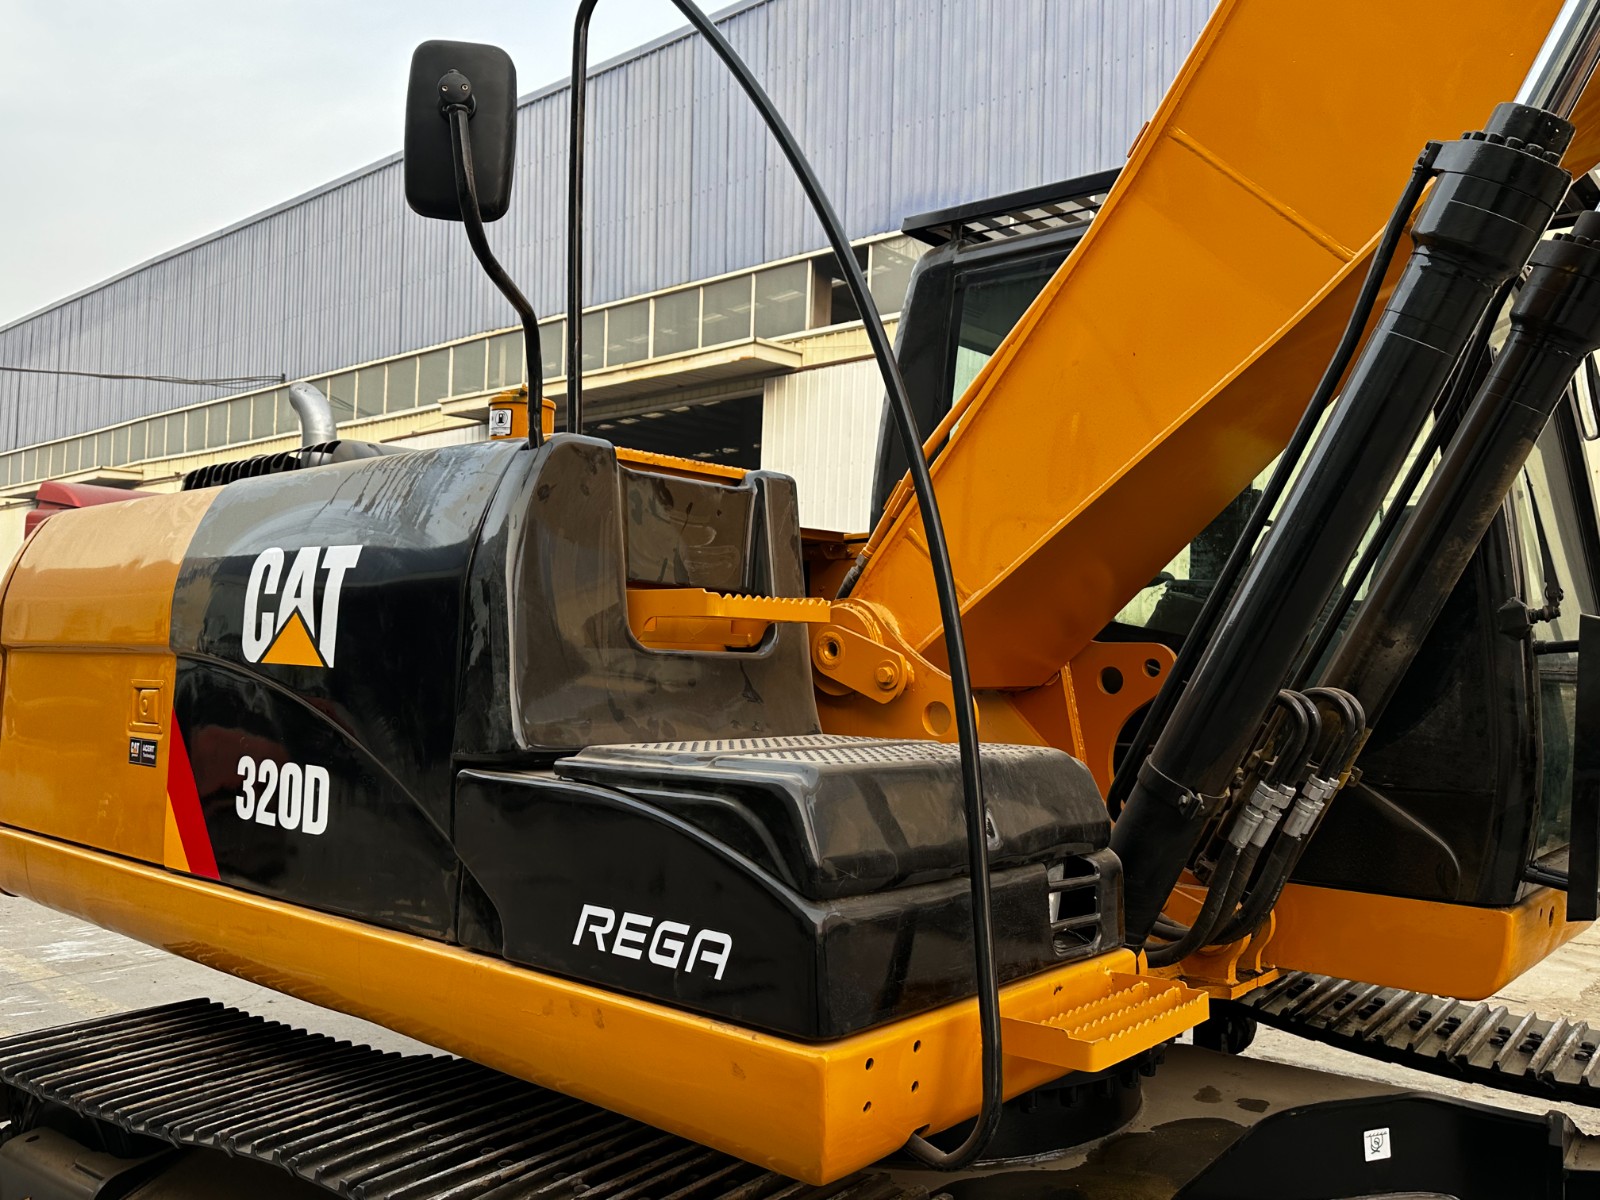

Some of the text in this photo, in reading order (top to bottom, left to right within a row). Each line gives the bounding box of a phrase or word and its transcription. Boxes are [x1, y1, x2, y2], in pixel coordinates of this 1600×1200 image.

[242, 545, 363, 668] CAT
[236, 756, 330, 835] 320D
[573, 904, 733, 981] REGA
